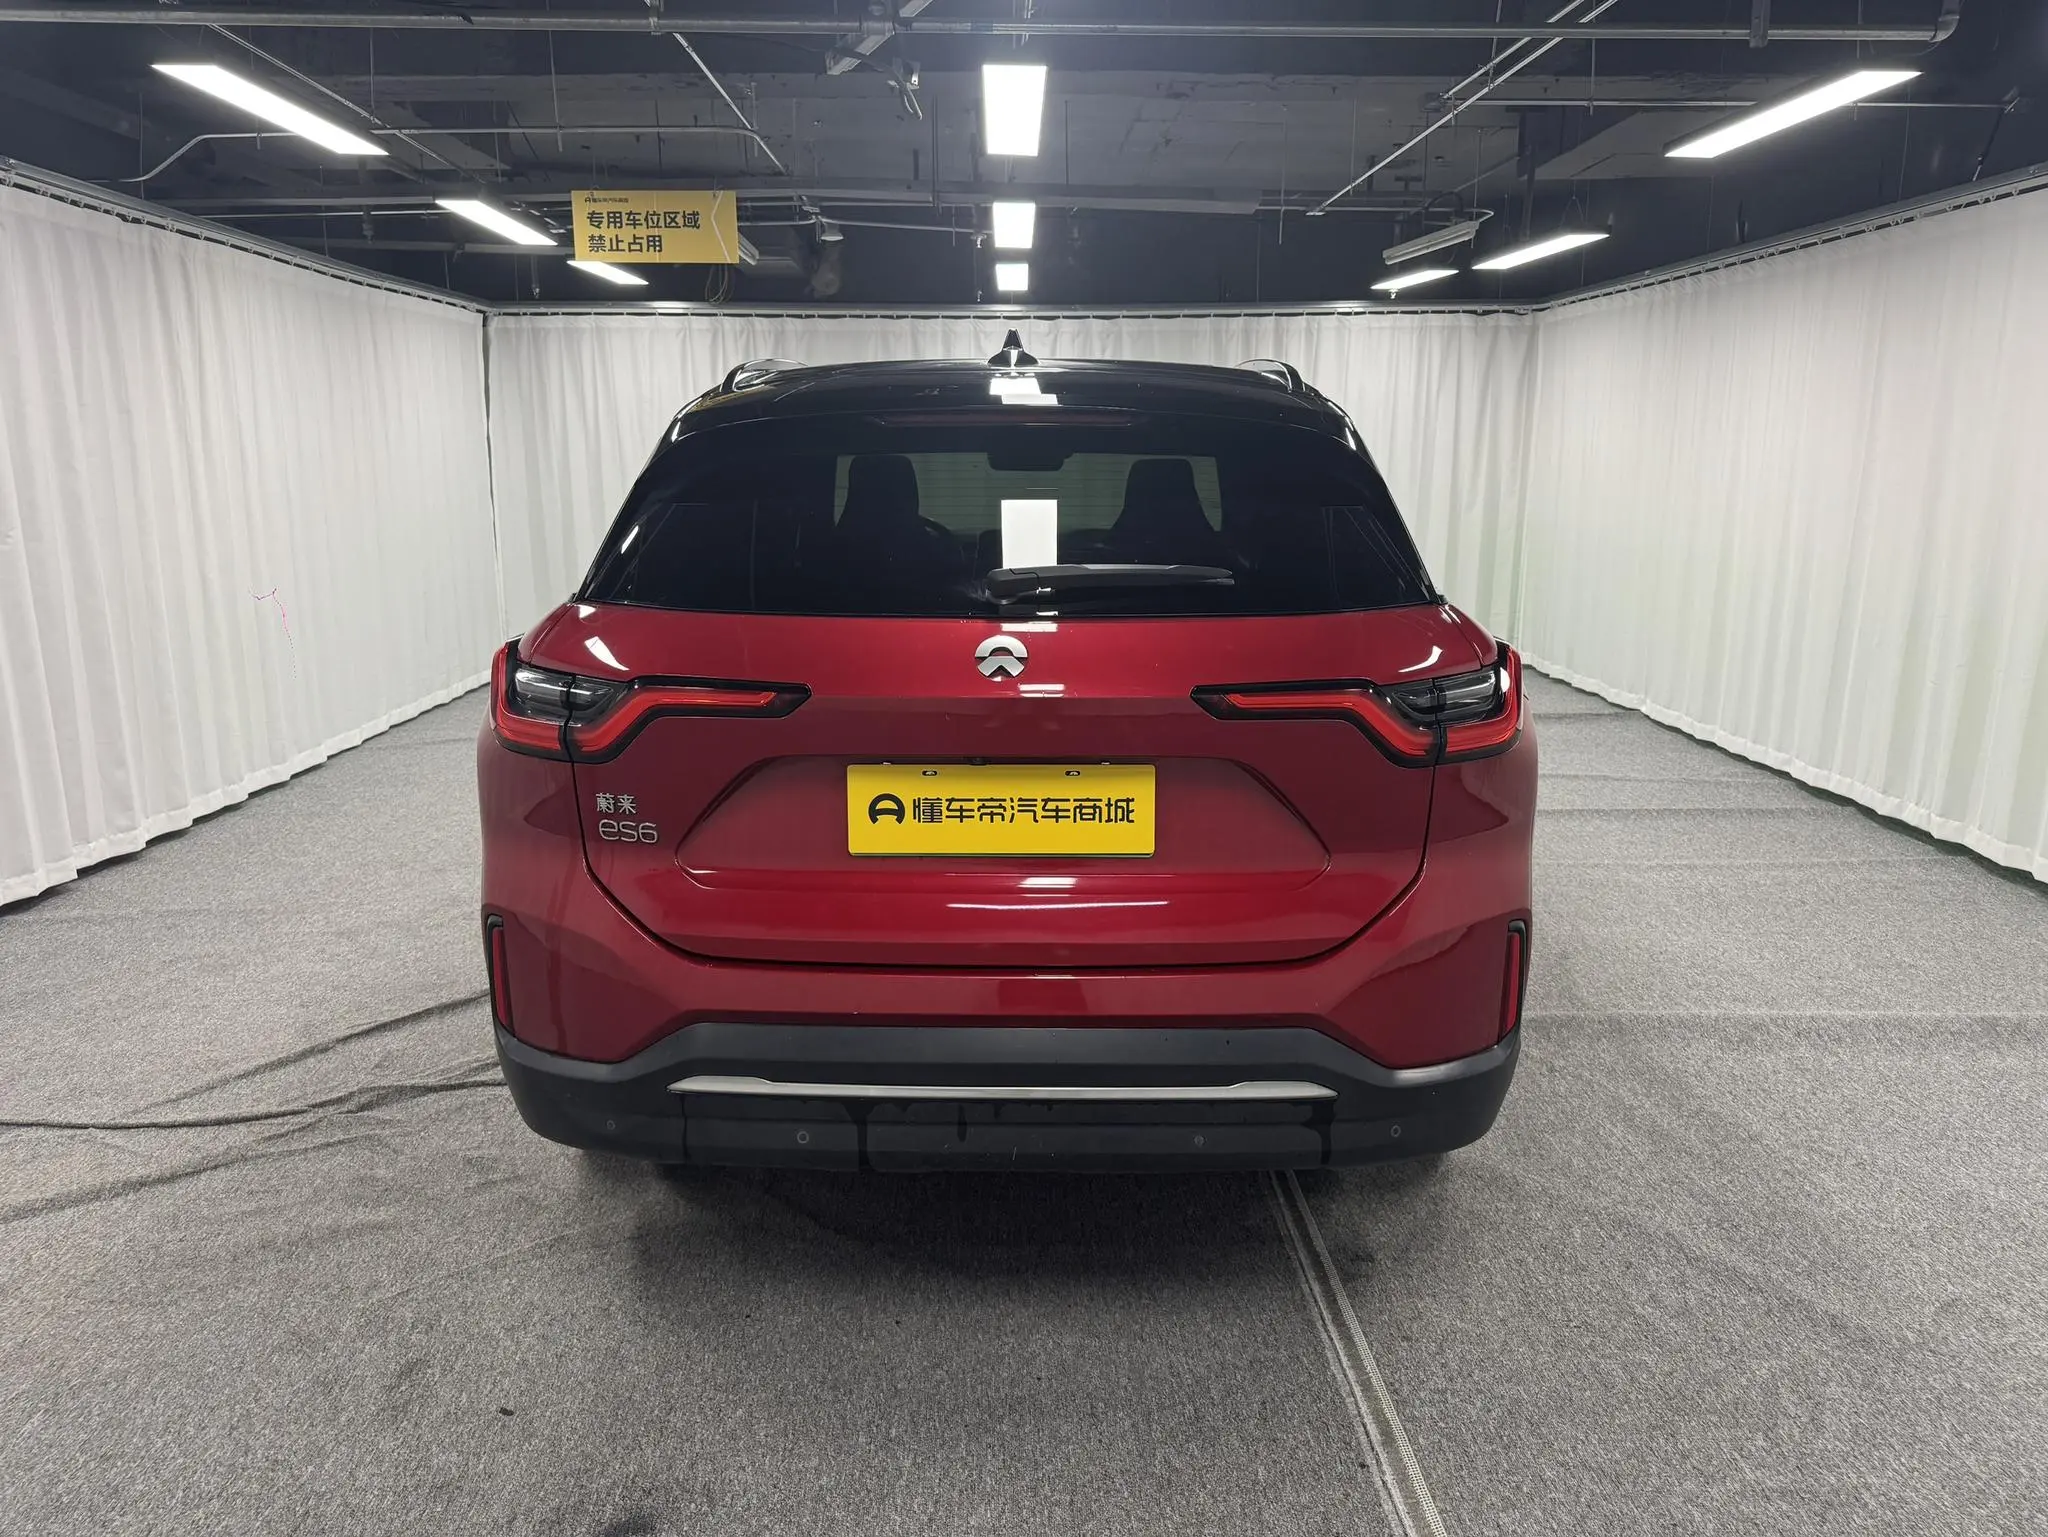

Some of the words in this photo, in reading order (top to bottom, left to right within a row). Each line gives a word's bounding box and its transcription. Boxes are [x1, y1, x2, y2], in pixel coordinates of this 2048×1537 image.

[586, 210, 701, 230] 专用车位区域
[588, 234, 663, 253] 禁止占用
[595, 792, 637, 815] 蔚来
[911, 797, 1135, 824] 懂车帝汽车商城
